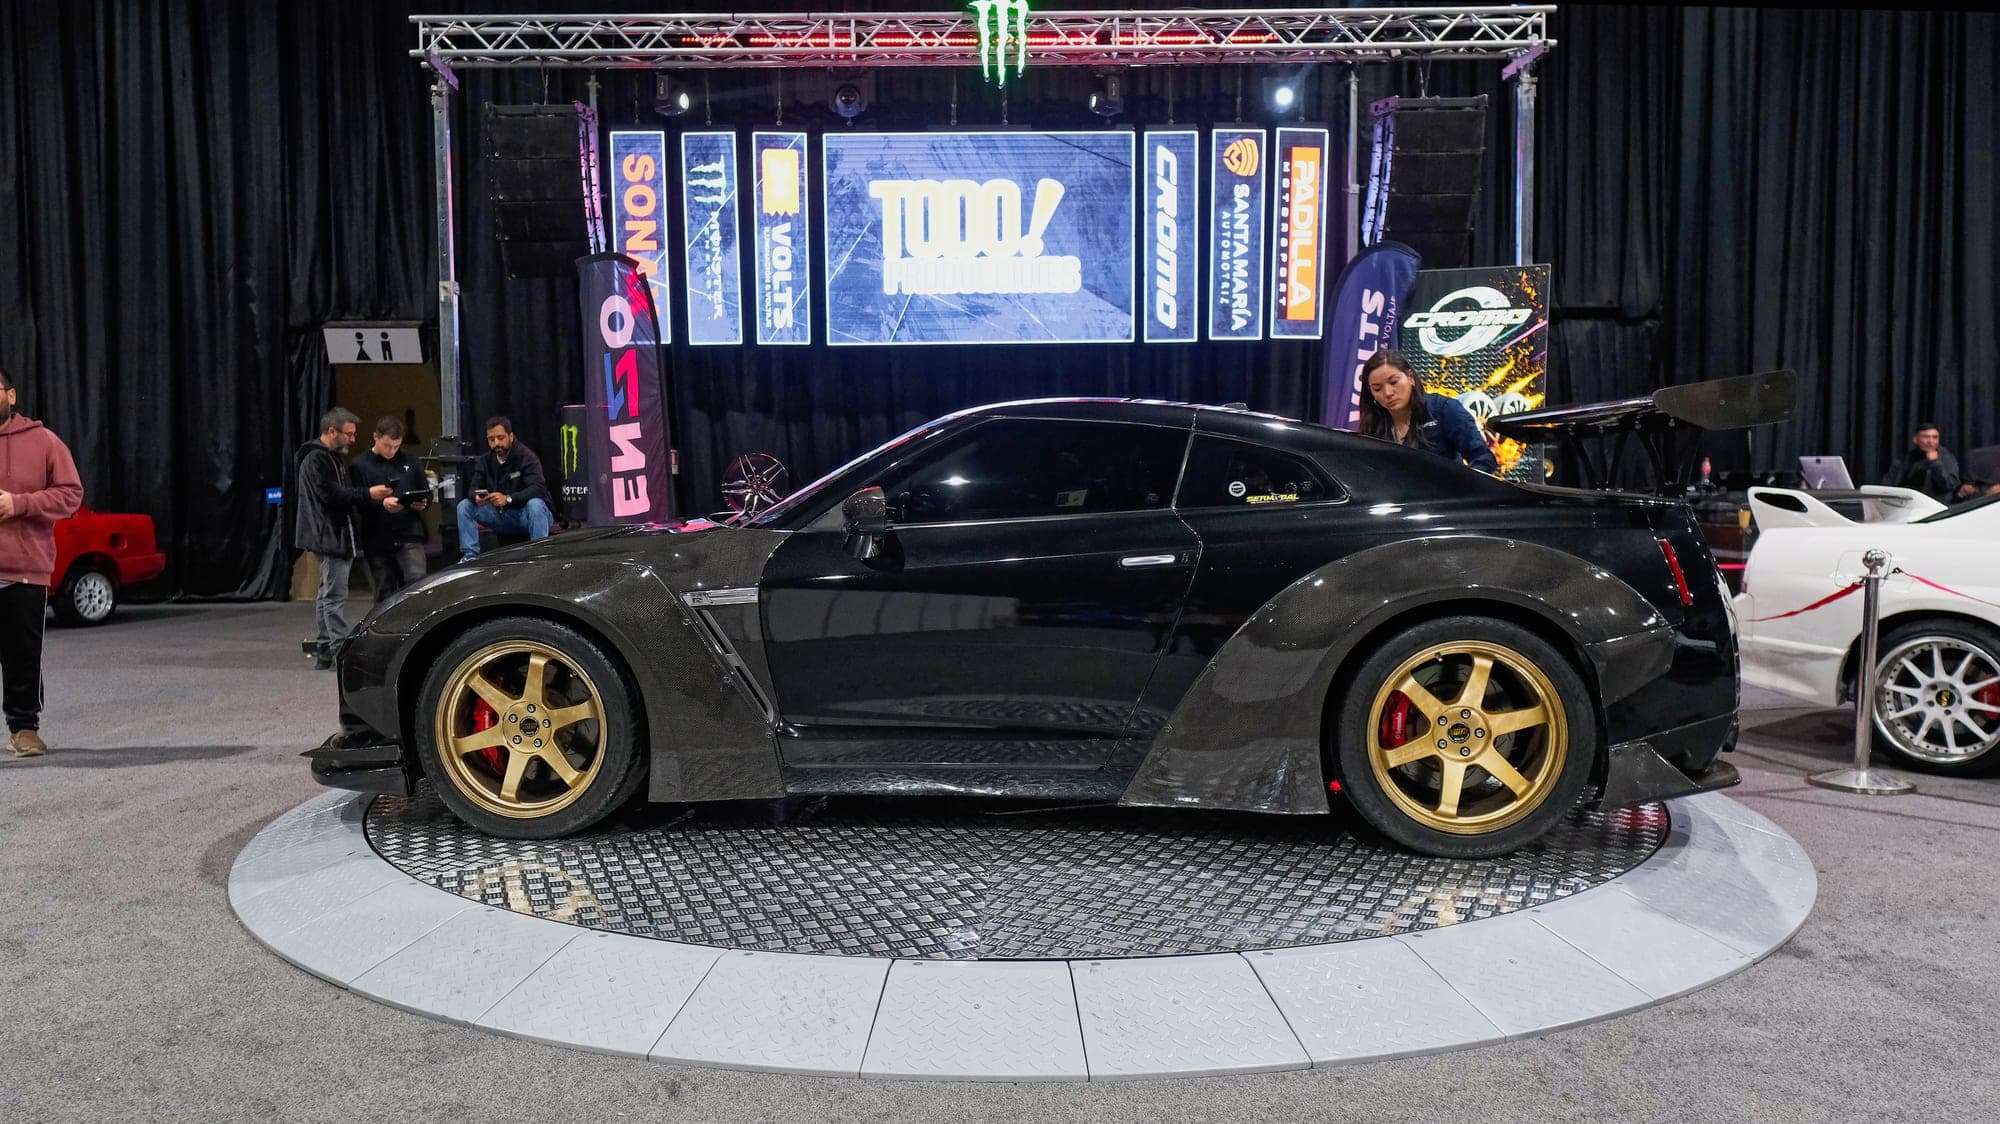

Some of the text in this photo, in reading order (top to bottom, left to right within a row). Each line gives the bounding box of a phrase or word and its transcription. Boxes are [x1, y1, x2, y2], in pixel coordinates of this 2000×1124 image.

[623, 153, 660, 316] SONA
[771, 222, 793, 329] VOLTS
[1157, 145, 1178, 330] CROMO
[1220, 211, 1231, 305] AUTOMOTRIZ
[1231, 184, 1252, 331] SANTAMARÍA
[1279, 161, 1290, 306] MOTORSPORT
[1289, 160, 1315, 307] PADILLA
[1403, 308, 1533, 329] CROMO
